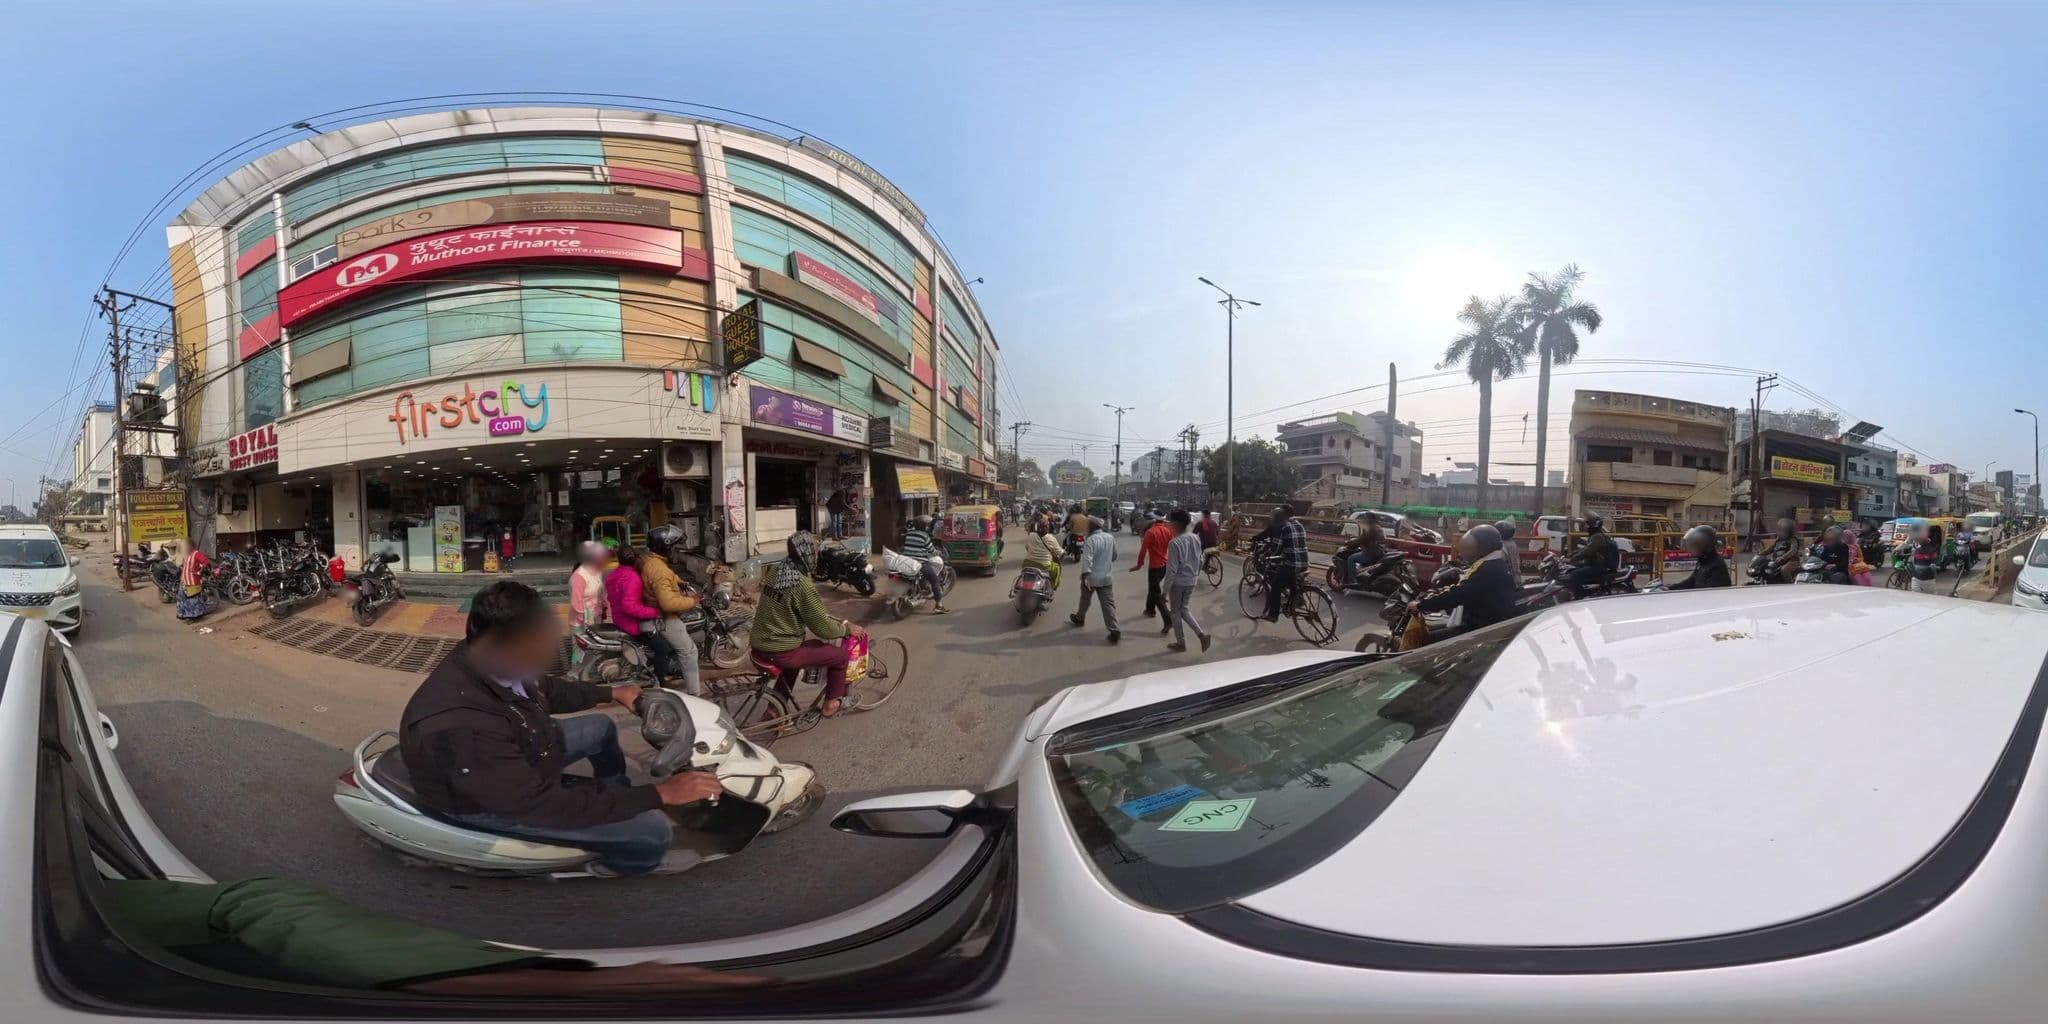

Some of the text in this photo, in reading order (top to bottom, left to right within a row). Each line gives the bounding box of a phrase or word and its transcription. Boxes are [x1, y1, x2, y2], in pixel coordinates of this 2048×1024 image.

[411, 239, 582, 266] Muthoot Finance
[388, 379, 549, 445] firstcry
[491, 419, 522, 432] .com
[229, 424, 278, 458] ROYAL
[1183, 804, 1238, 826] CNG
